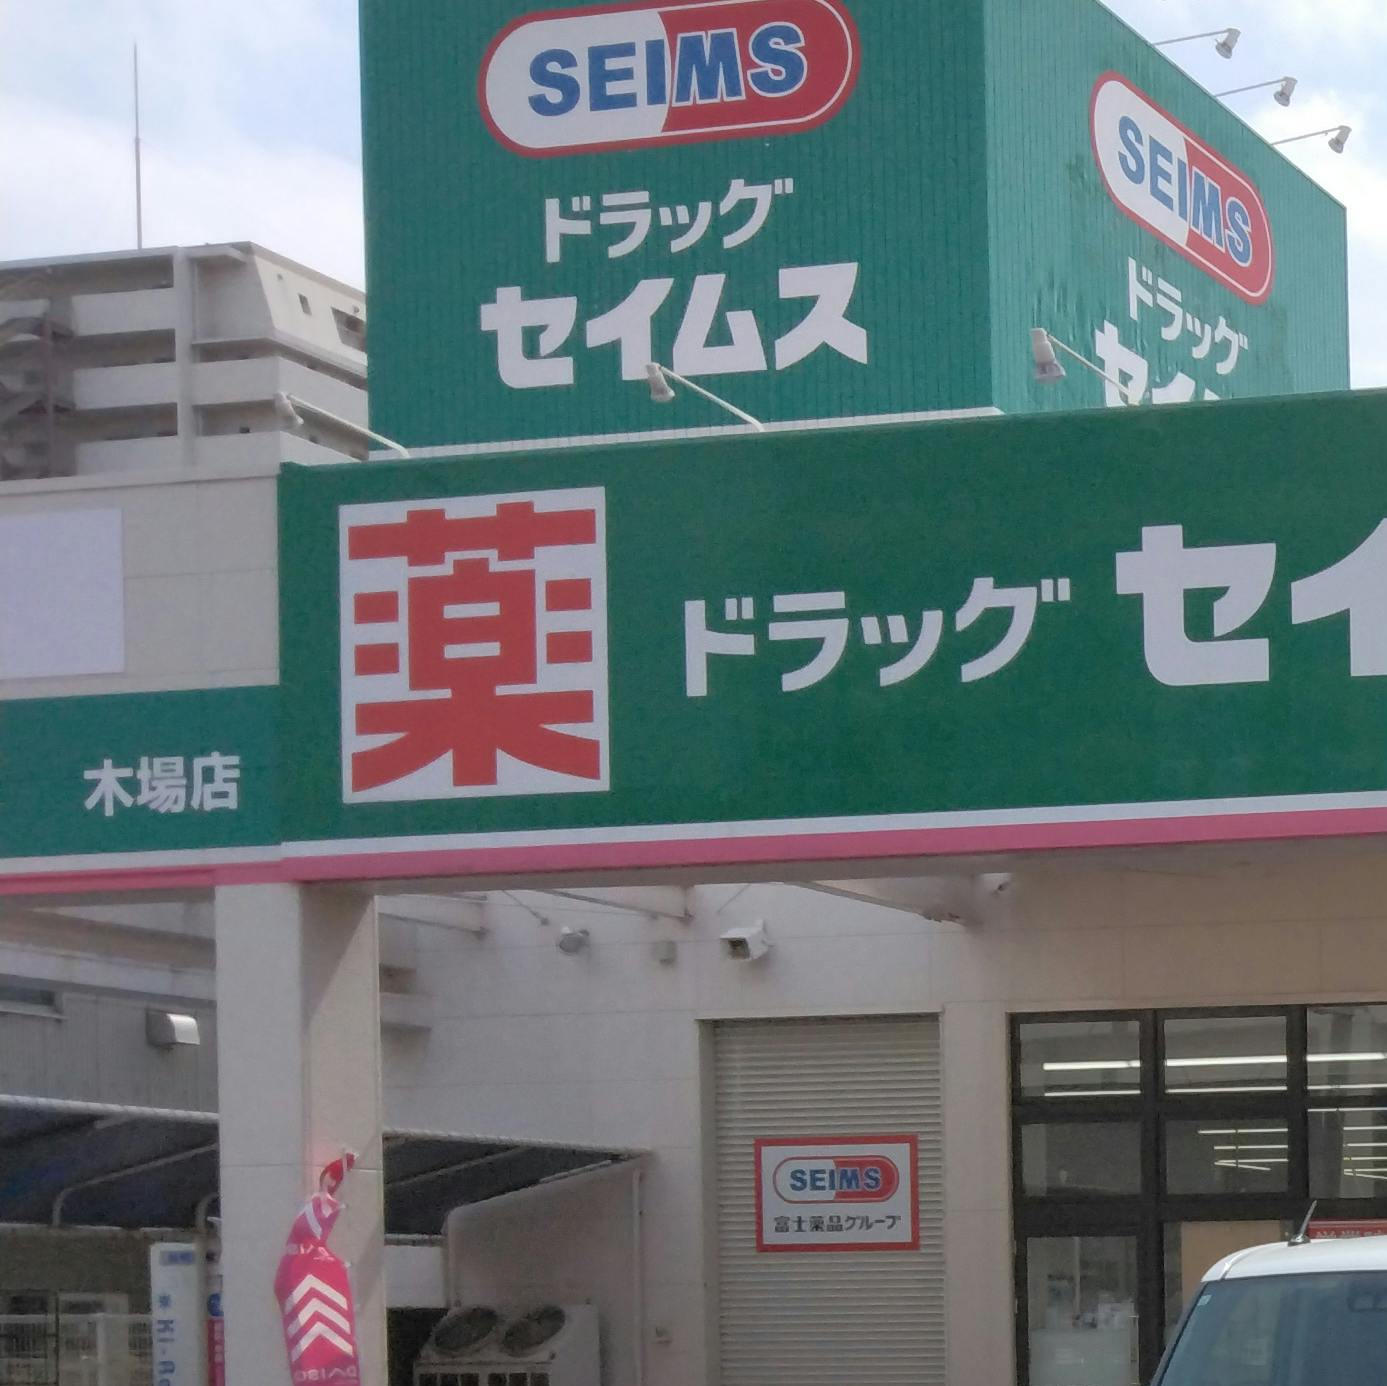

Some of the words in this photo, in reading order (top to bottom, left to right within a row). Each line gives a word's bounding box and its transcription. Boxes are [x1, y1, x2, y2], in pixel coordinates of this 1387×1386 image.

[528, 22, 808, 117] SEIMS
[544, 177, 795, 264] ドラッグ
[1117, 114, 1253, 267] SEIMS
[480, 261, 869, 390] セイムス
[1127, 256, 1249, 376] ドラッグ
[348, 500, 601, 793] 薬
[684, 577, 1071, 696] ドラッグ
[83, 751, 241, 817] 木場店
[774, 1214, 902, 1233] 富士薬品グループ
[789, 1167, 882, 1192] SEIMS
